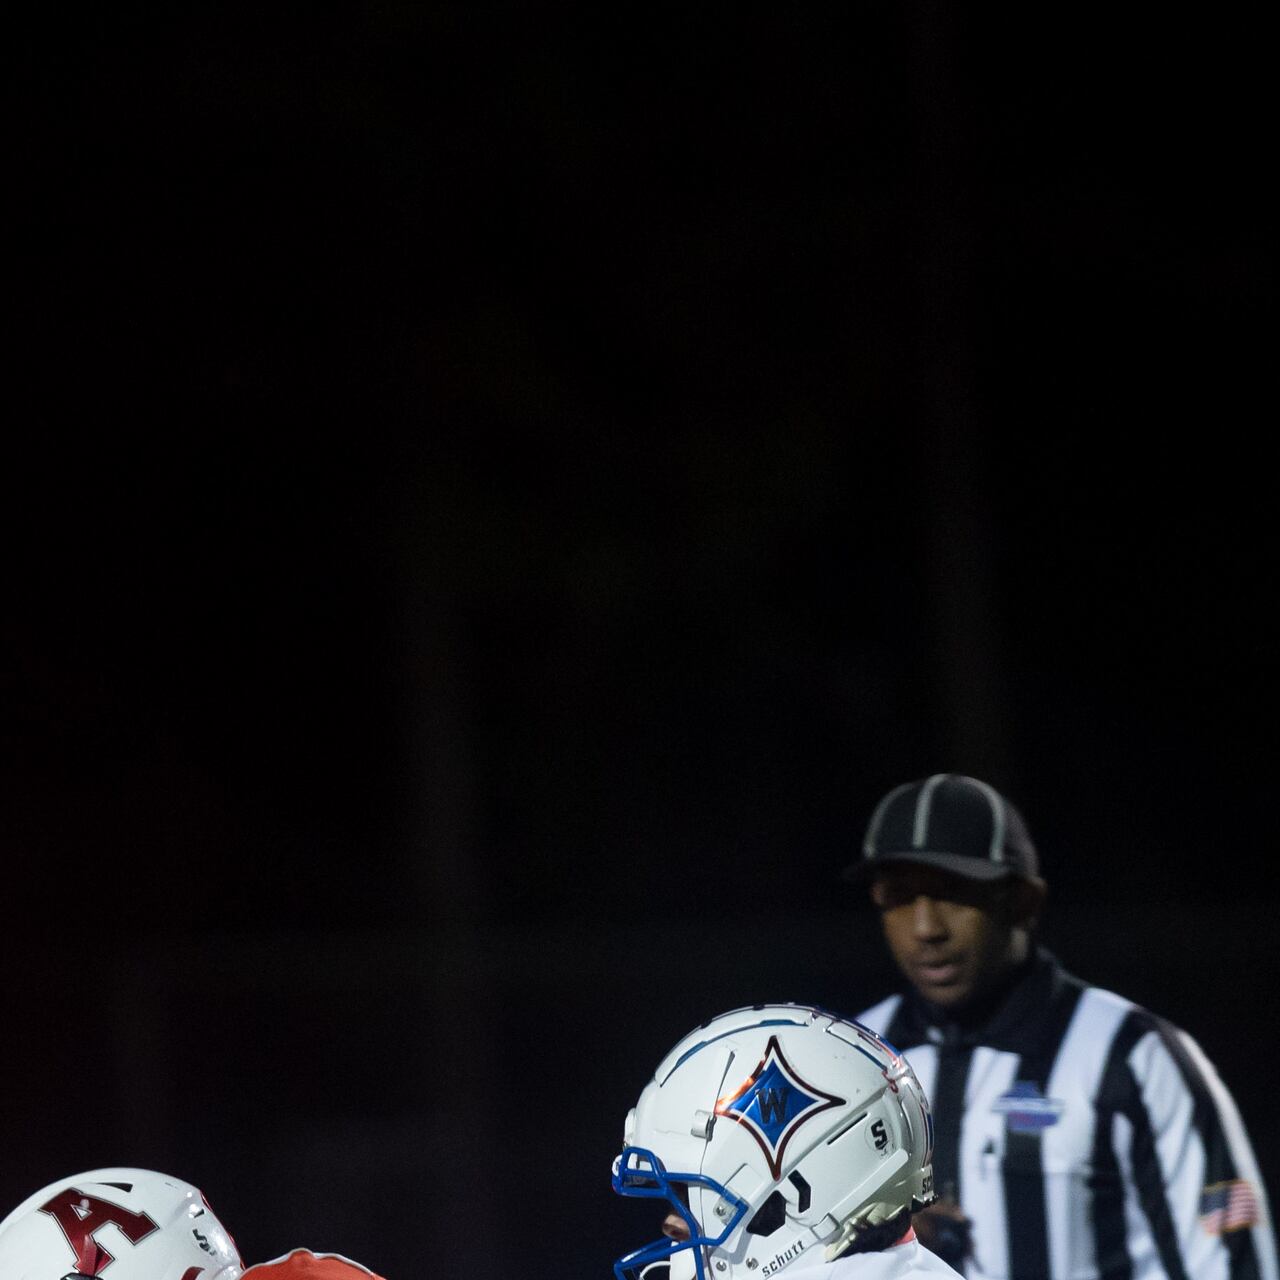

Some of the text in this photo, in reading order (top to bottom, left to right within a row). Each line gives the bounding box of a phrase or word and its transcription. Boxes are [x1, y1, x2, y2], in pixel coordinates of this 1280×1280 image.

[754, 1087, 790, 1125] W
[36, 1186, 161, 1277] A
[761, 1240, 805, 1277] schutt
